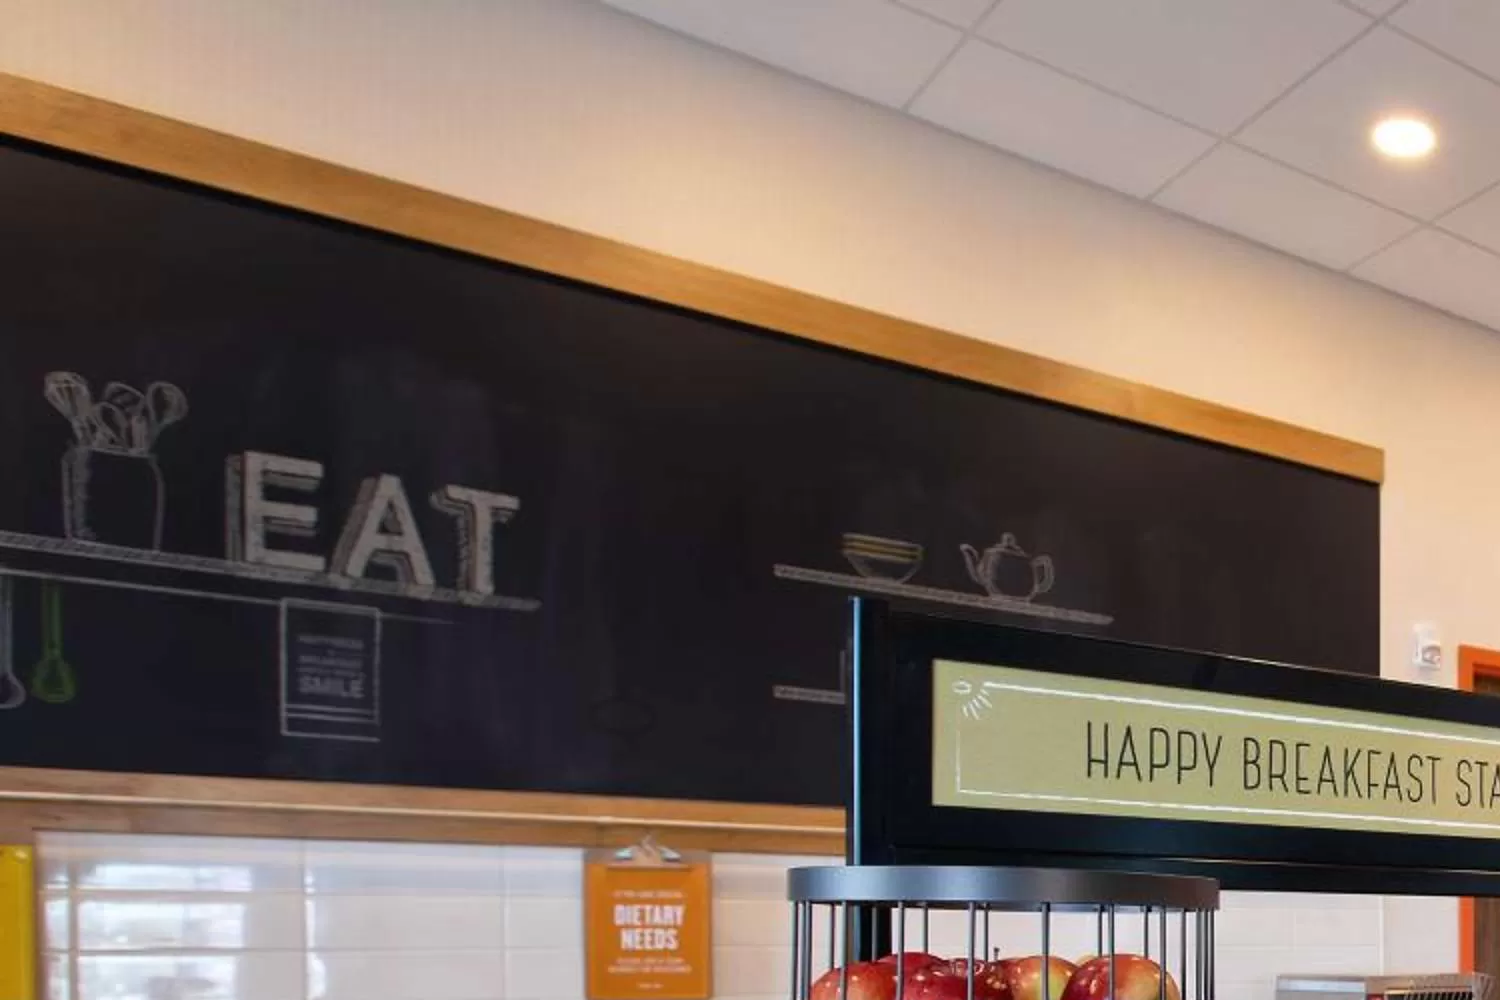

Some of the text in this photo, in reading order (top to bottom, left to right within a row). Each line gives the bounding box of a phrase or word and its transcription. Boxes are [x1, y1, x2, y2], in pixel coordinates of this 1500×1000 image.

[225, 449, 521, 601] EAT
[1086, 720, 1223, 788] HAPPY
[1242, 736, 1441, 805] BREAKFAST
[612, 903, 685, 927] DIETARY
[620, 927, 680, 951] NEEDS
